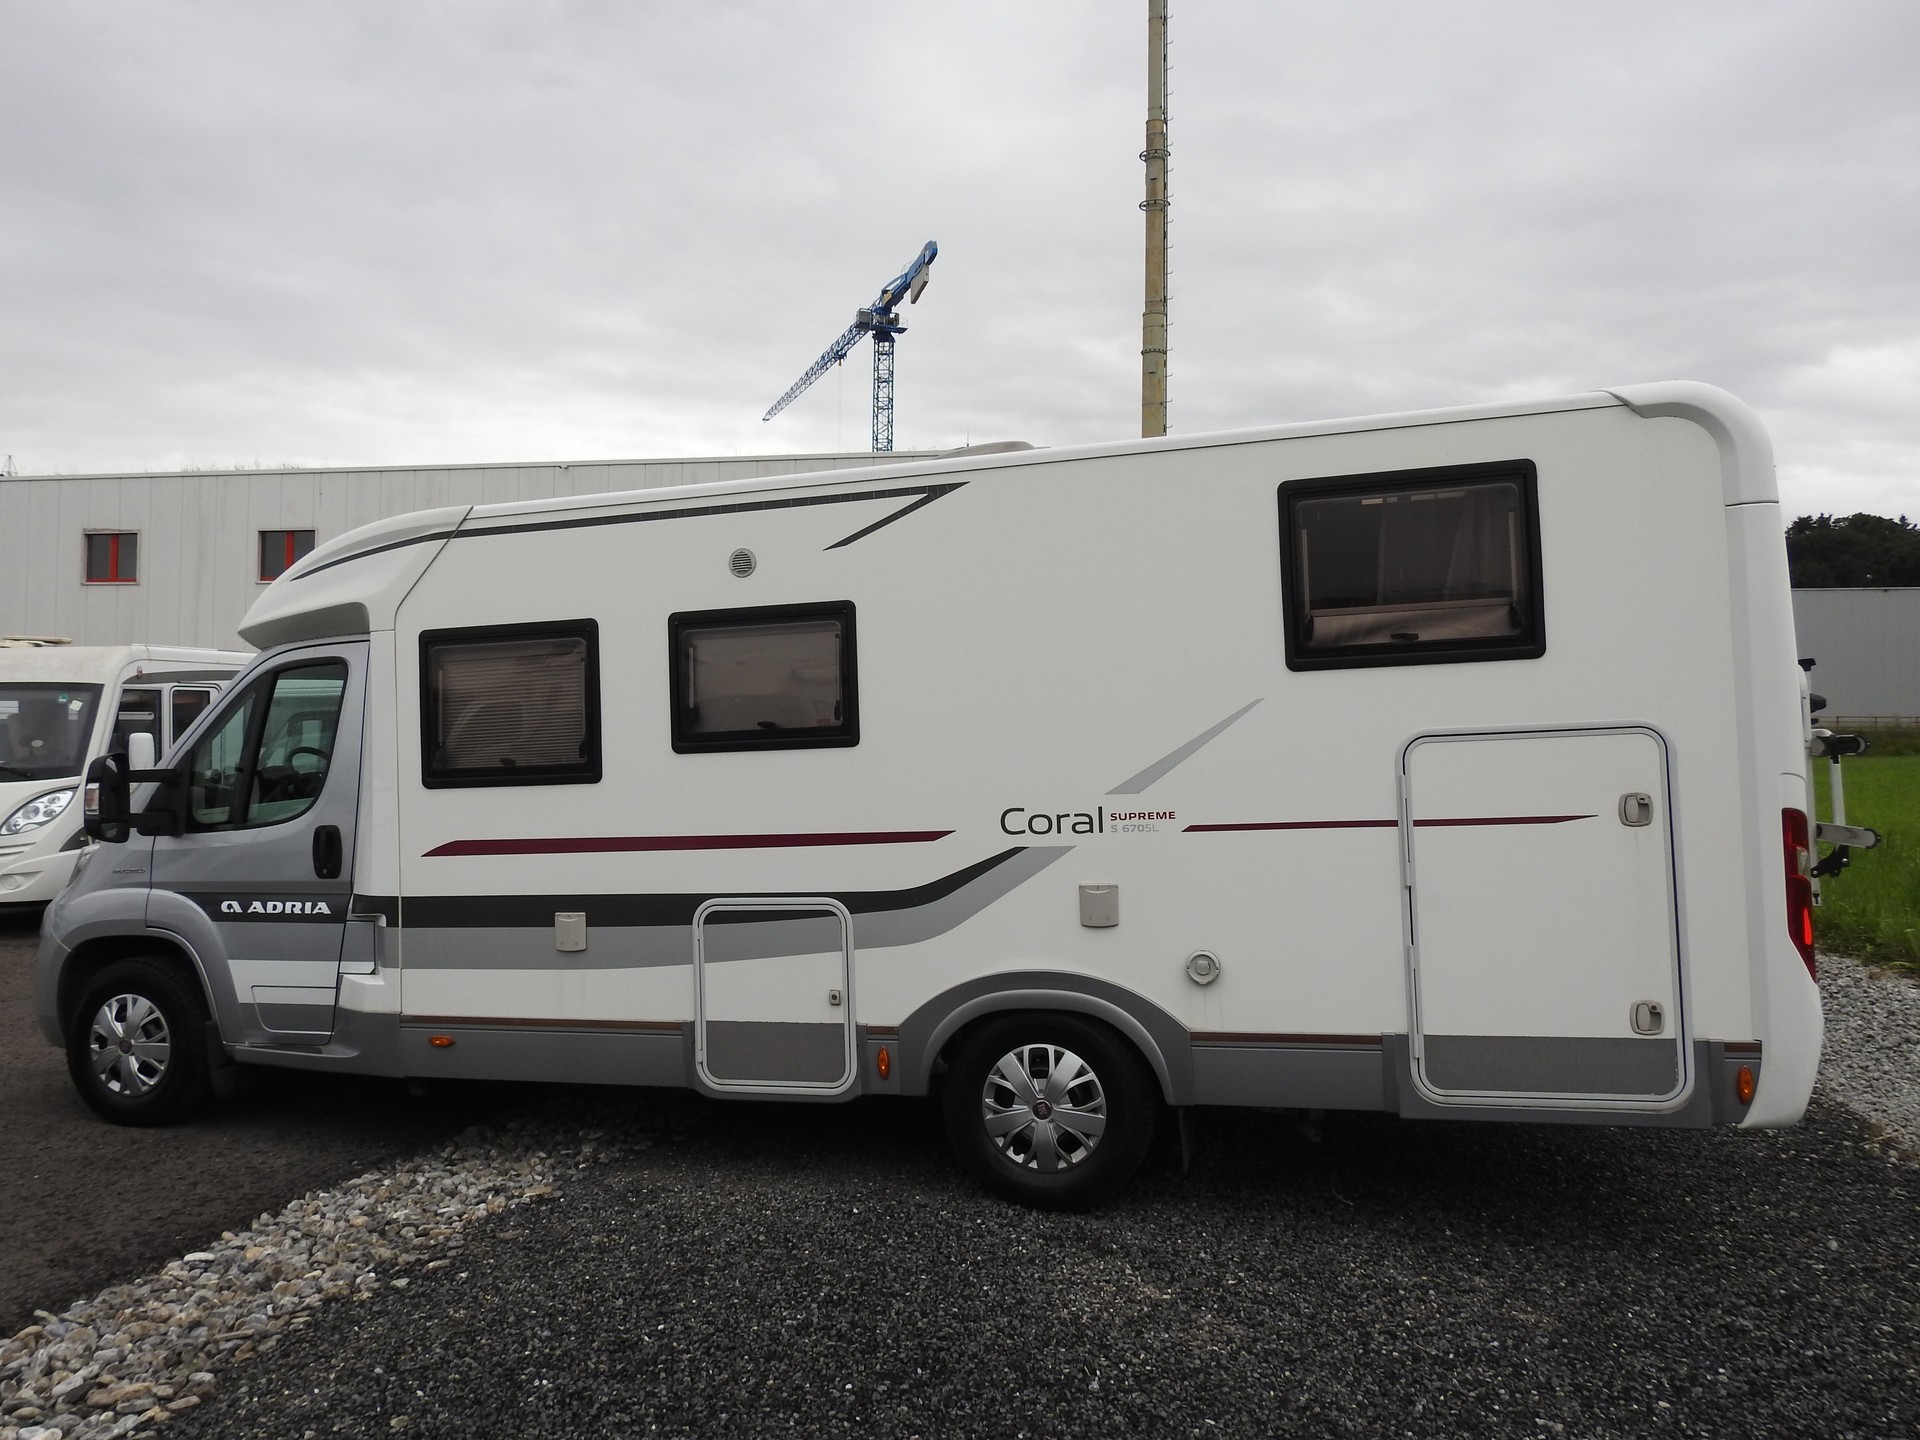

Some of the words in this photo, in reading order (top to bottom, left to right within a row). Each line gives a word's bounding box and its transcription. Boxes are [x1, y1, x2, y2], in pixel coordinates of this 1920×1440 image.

[1000, 806, 1104, 836] Coral
[1110, 811, 1176, 821] SUPREME
[1110, 824, 1118, 833] S
[1122, 823, 1160, 833] 670SL
[247, 901, 332, 915] ADRIA
